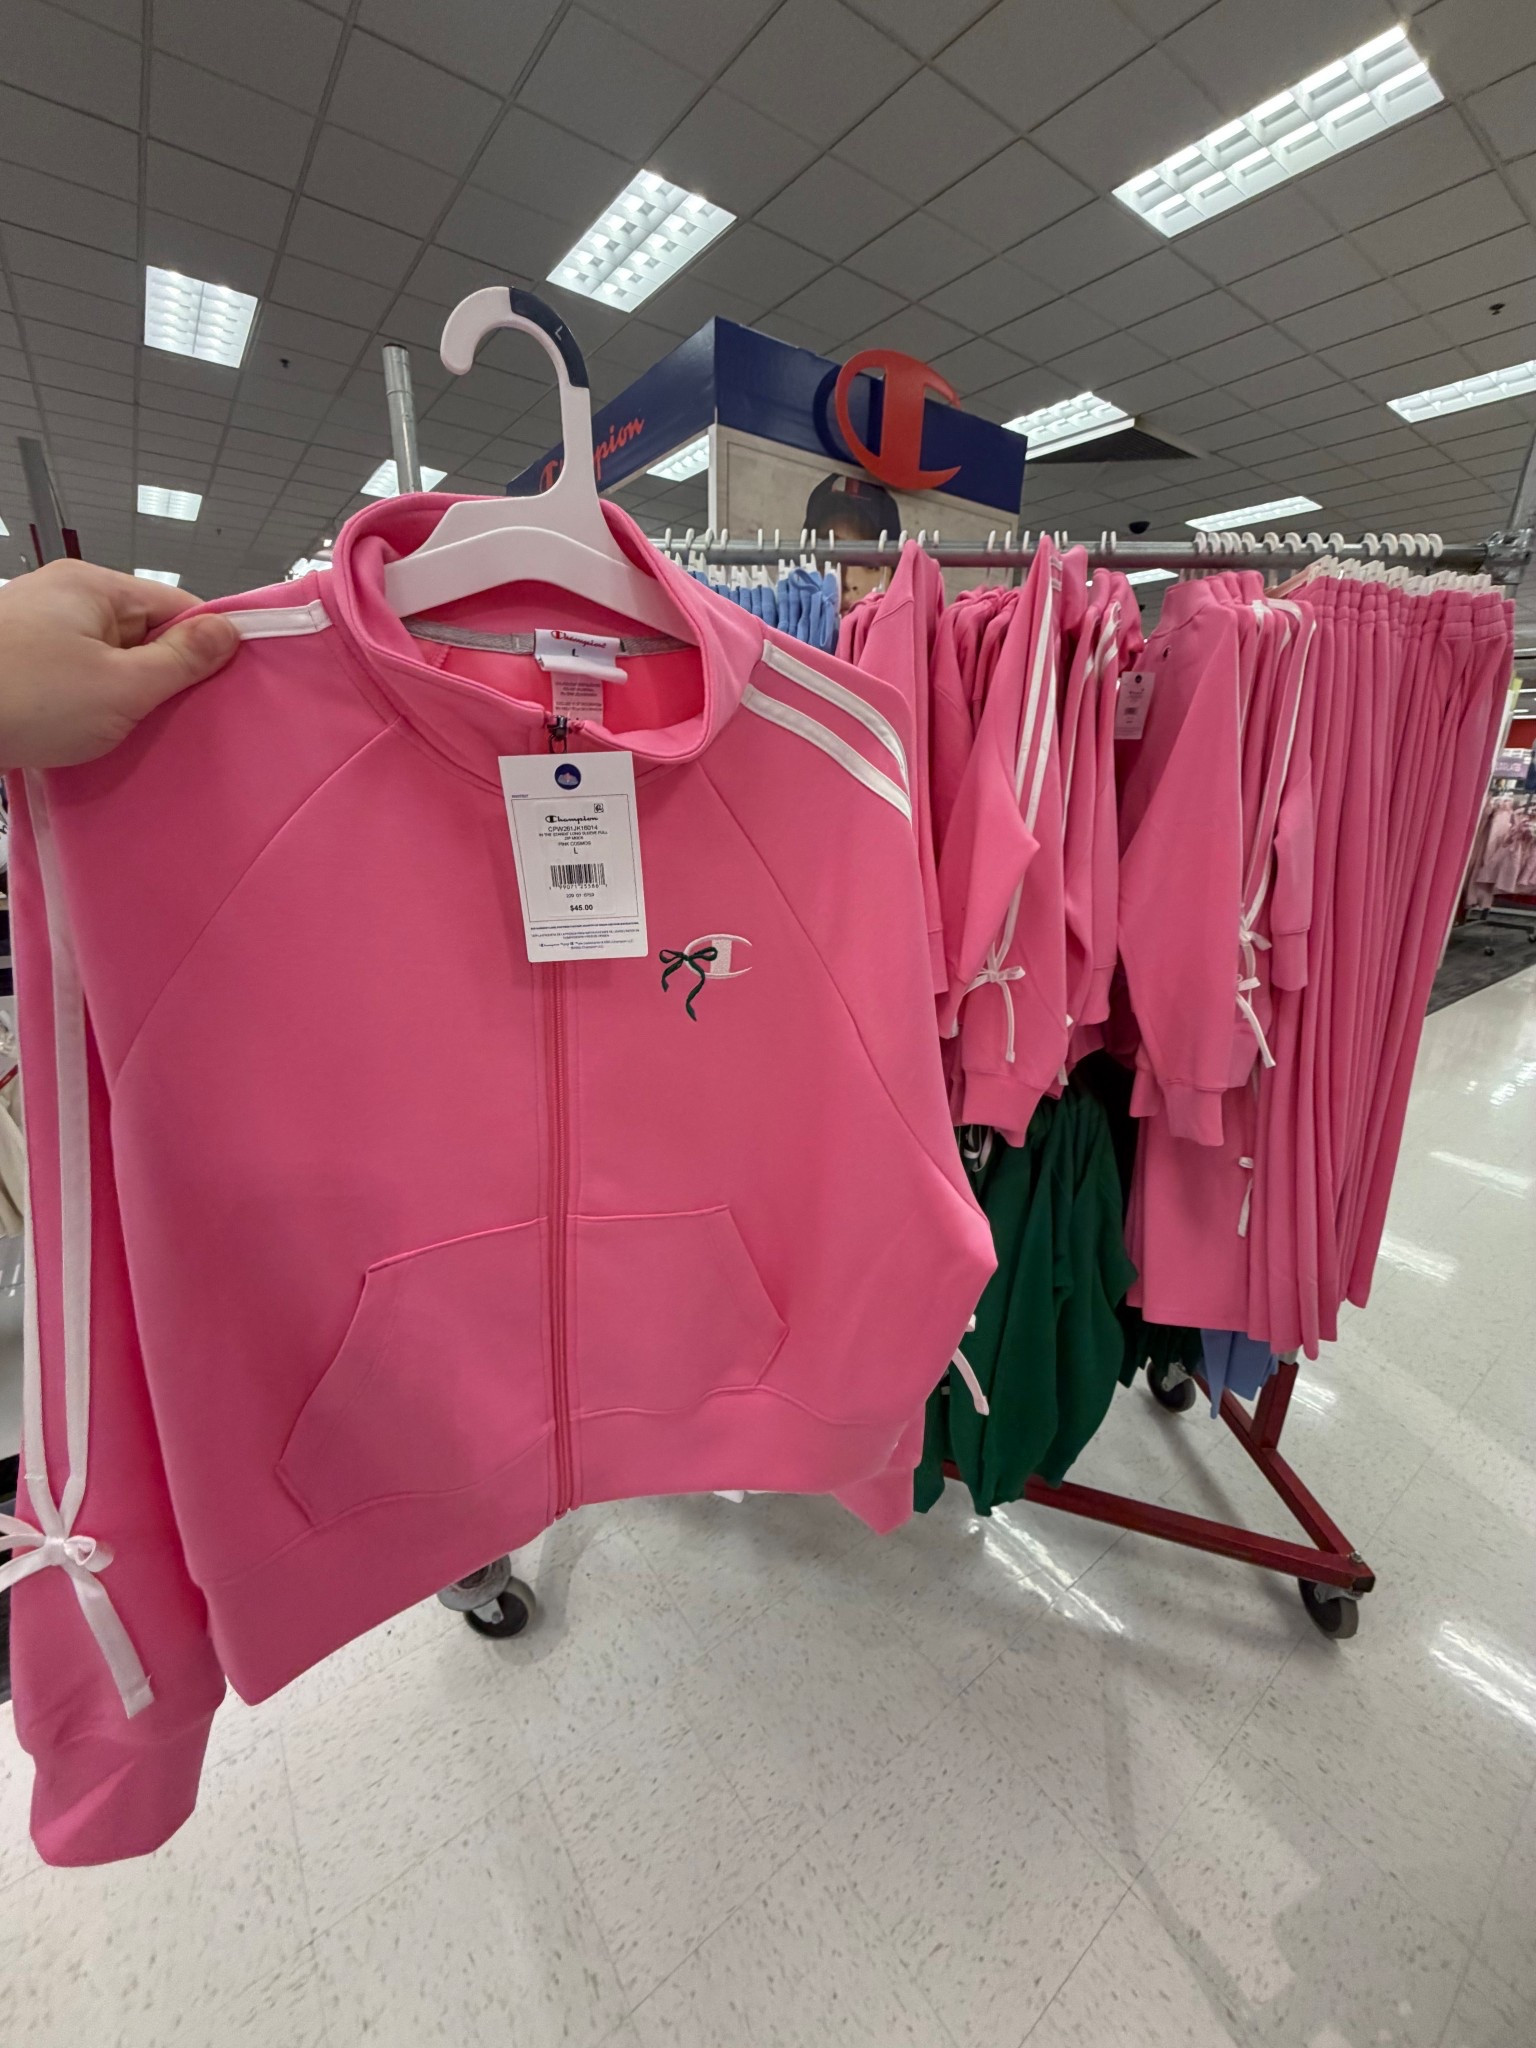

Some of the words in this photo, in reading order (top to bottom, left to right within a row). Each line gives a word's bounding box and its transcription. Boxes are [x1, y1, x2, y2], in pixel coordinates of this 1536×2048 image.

[554, 325, 564, 341] L
[571, 647, 580, 658] L
[545, 815, 598, 824] Champion
[569, 904, 594, 912] $45.00
